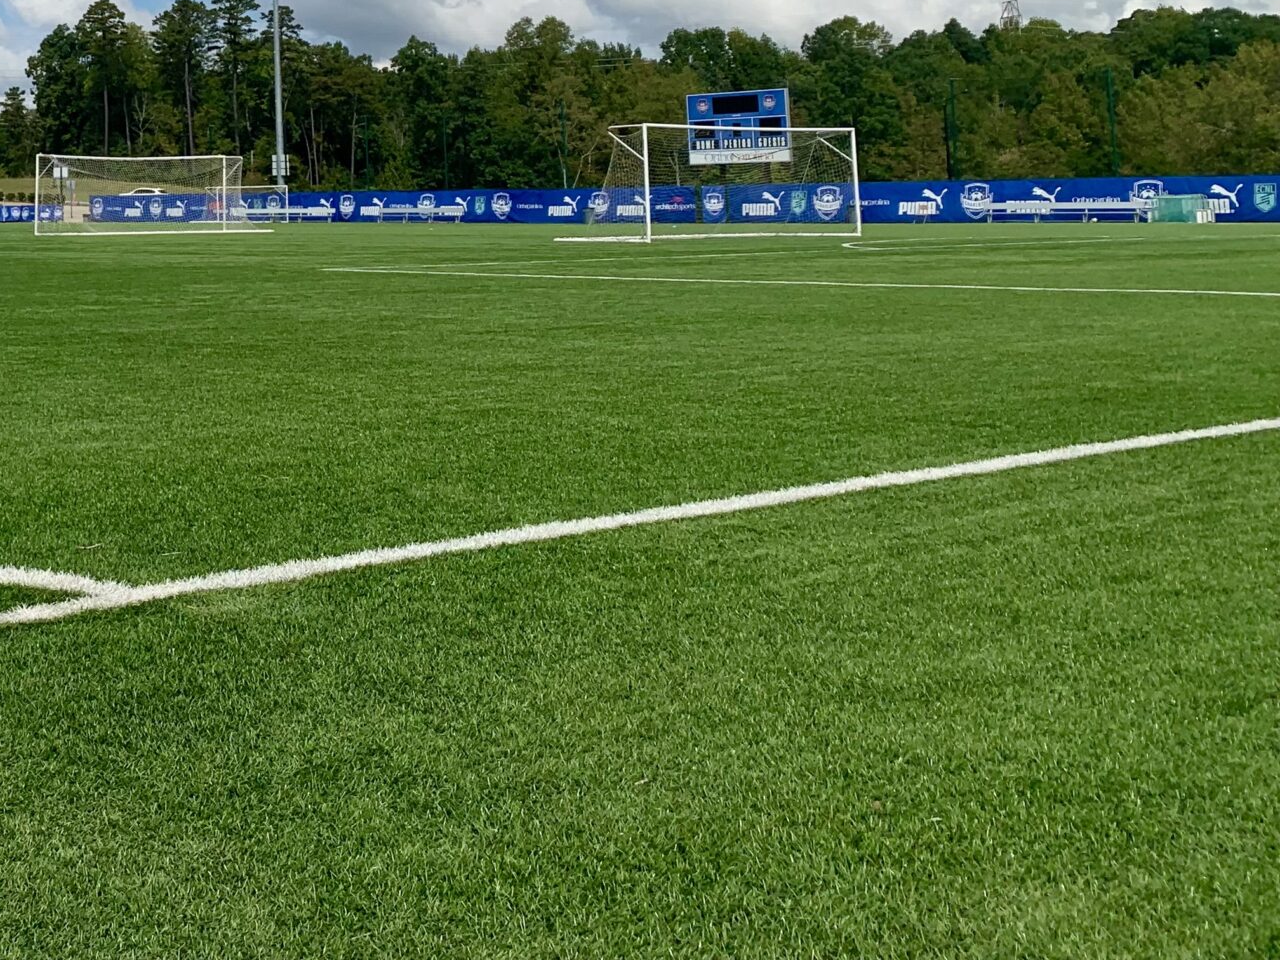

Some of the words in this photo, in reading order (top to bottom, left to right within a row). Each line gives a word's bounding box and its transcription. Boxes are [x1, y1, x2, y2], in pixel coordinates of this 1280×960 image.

[548, 206, 573, 216] PUMA
[616, 205, 644, 216] PUMA
[742, 203, 775, 216] PUMA
[898, 201, 937, 215] PUMA
